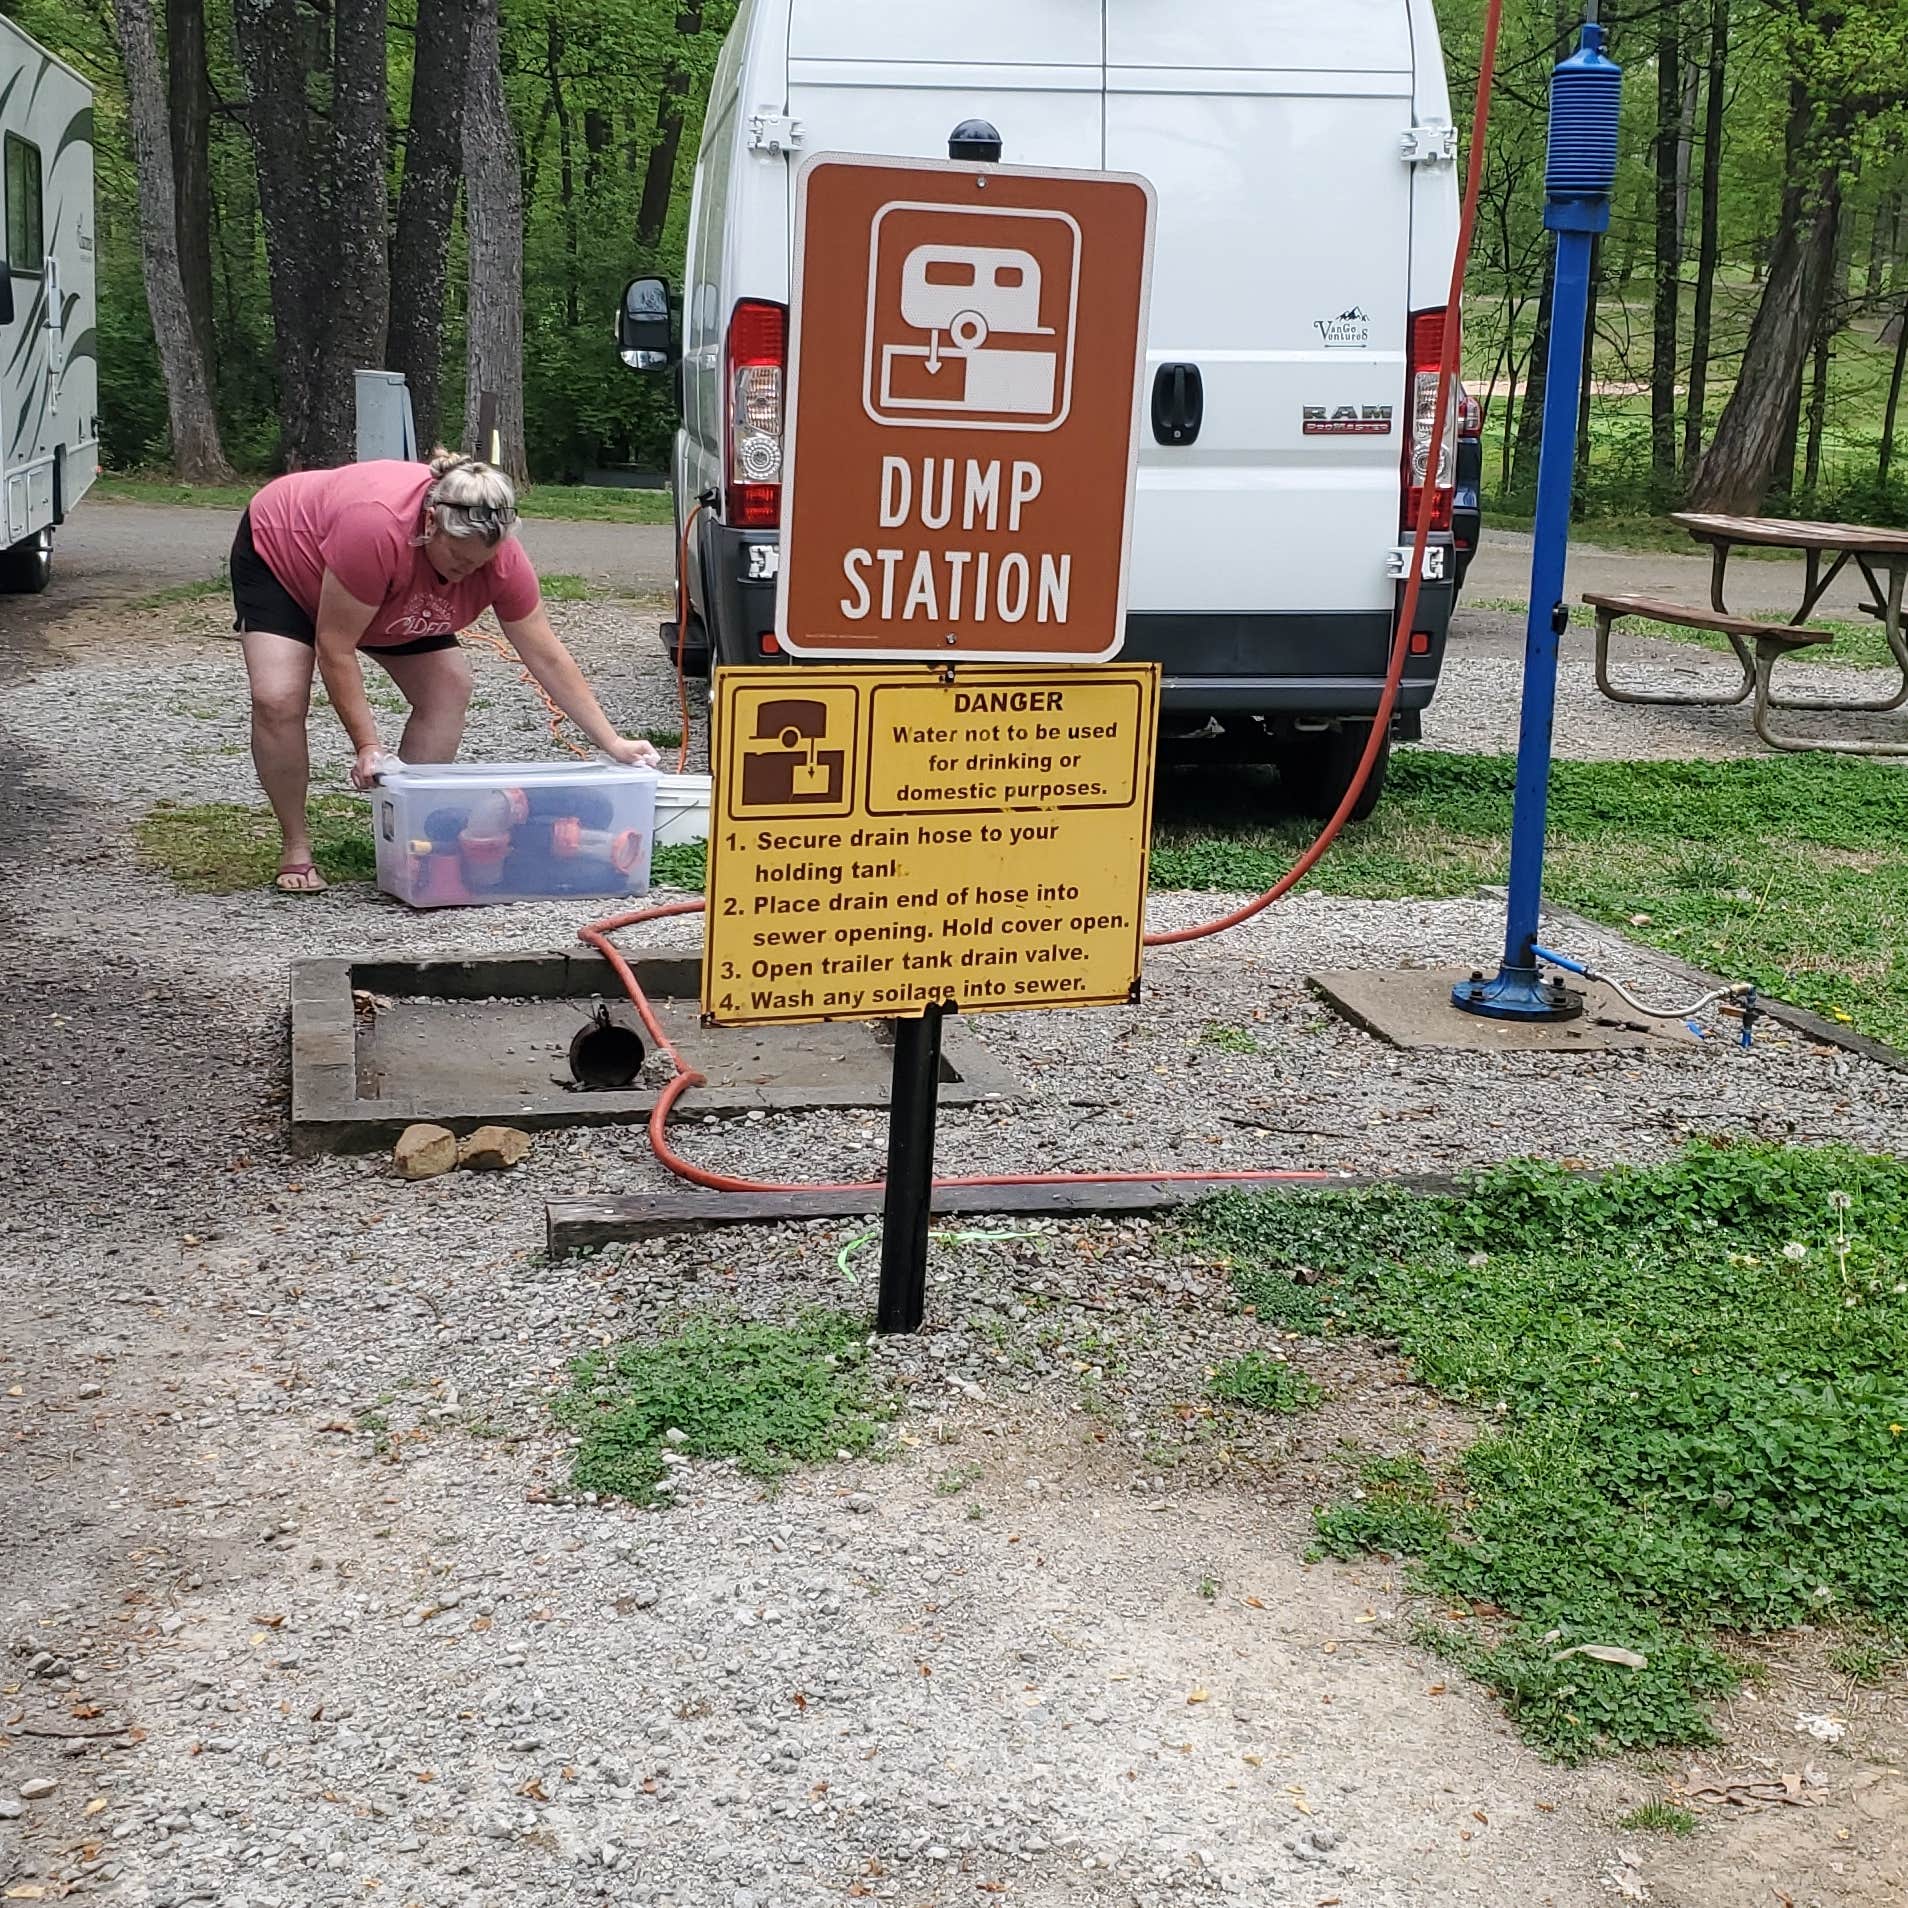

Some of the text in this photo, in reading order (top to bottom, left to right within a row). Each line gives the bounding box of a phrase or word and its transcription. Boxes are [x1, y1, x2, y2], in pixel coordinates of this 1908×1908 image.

[1302, 404, 1393, 420] RAM
[879, 456, 1042, 531] DUMP
[840, 548, 1071, 623] STATION
[954, 691, 1064, 713] DANGER
[892, 721, 1118, 744] Water not to be used
[928, 752, 1082, 773] for drinking or
[896, 781, 1107, 803] domestic purposes.
[725, 824, 1060, 852] 1. Secure drain hose to your
[755, 862, 843, 885] holding
[723, 883, 1079, 916] 2. Place drain end of hose into
[752, 915, 1129, 947] sewer opening. Hold cover open.
[720, 943, 1089, 983] 3. Open trailer tank drain valve.
[718, 977, 1086, 1012] 4. Wash any soilage into sewer.
